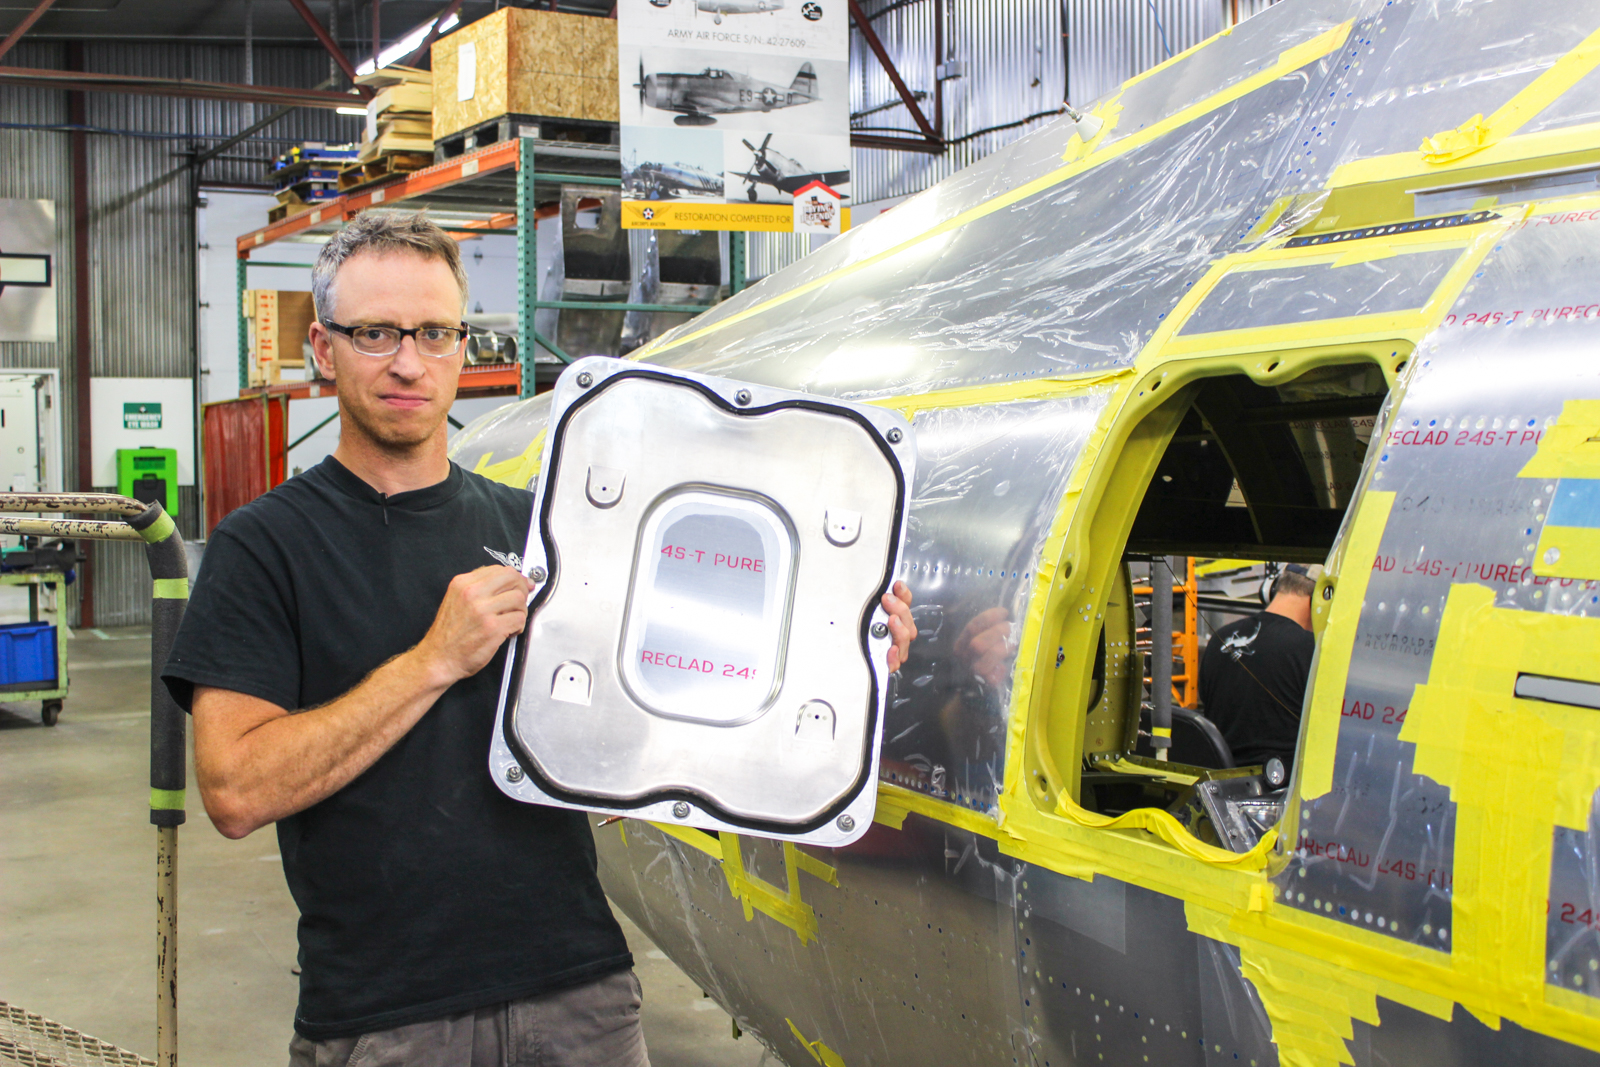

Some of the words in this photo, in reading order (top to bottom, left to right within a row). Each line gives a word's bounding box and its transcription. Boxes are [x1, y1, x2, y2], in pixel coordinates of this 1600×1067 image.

[667, 29, 693, 39] ARMY
[696, 31, 710, 40] AIR
[713, 32, 740, 43] FORCE
[767, 37, 806, 48] 42-27609
[674, 212, 728, 222] RESTORATION
[730, 213, 774, 224] COMPLETED
[776, 215, 792, 223] FOR
[1462, 310, 1524, 326] 24S-T
[1531, 304, 1600, 321] PUREC
[124, 413, 162, 421] EMERGENCY
[1454, 430, 1517, 446] 24S-T
[660, 545, 706, 563] 4S-T
[714, 553, 766, 573] PURE
[641, 650, 714, 673] RECLAD
